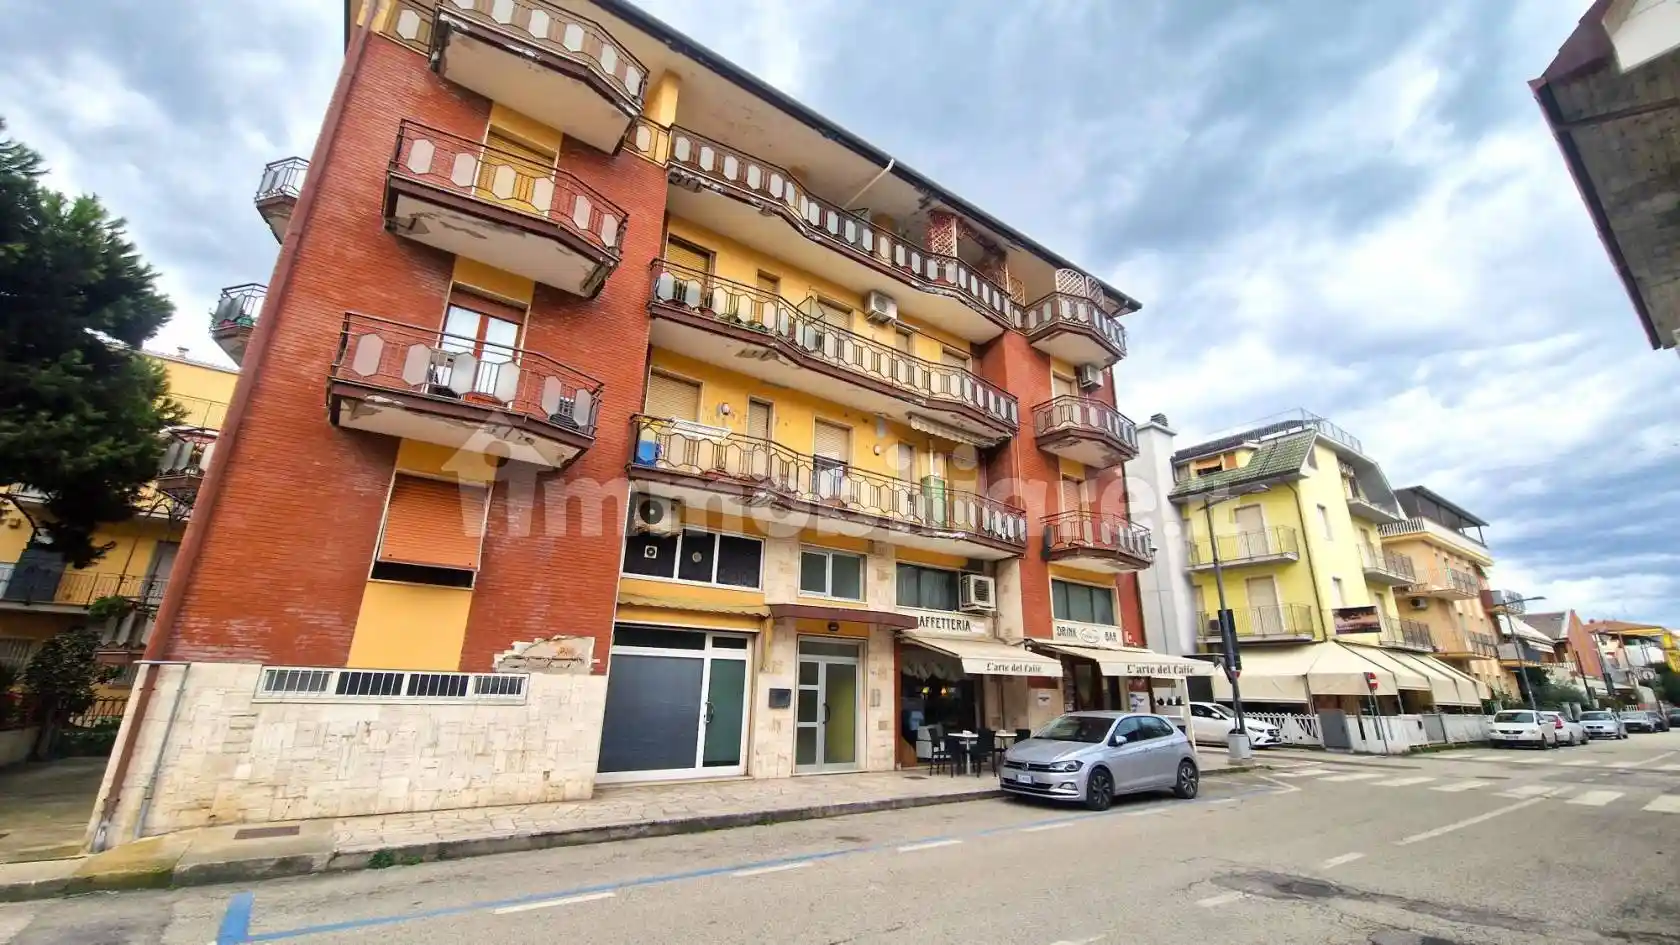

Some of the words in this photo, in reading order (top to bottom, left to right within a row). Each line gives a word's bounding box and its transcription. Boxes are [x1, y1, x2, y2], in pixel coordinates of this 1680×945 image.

[919, 615, 972, 633] AFFETTERIA
[1011, 663, 1023, 672] del
[1127, 663, 1155, 674] L'arte
[1157, 664, 1171, 674] del
